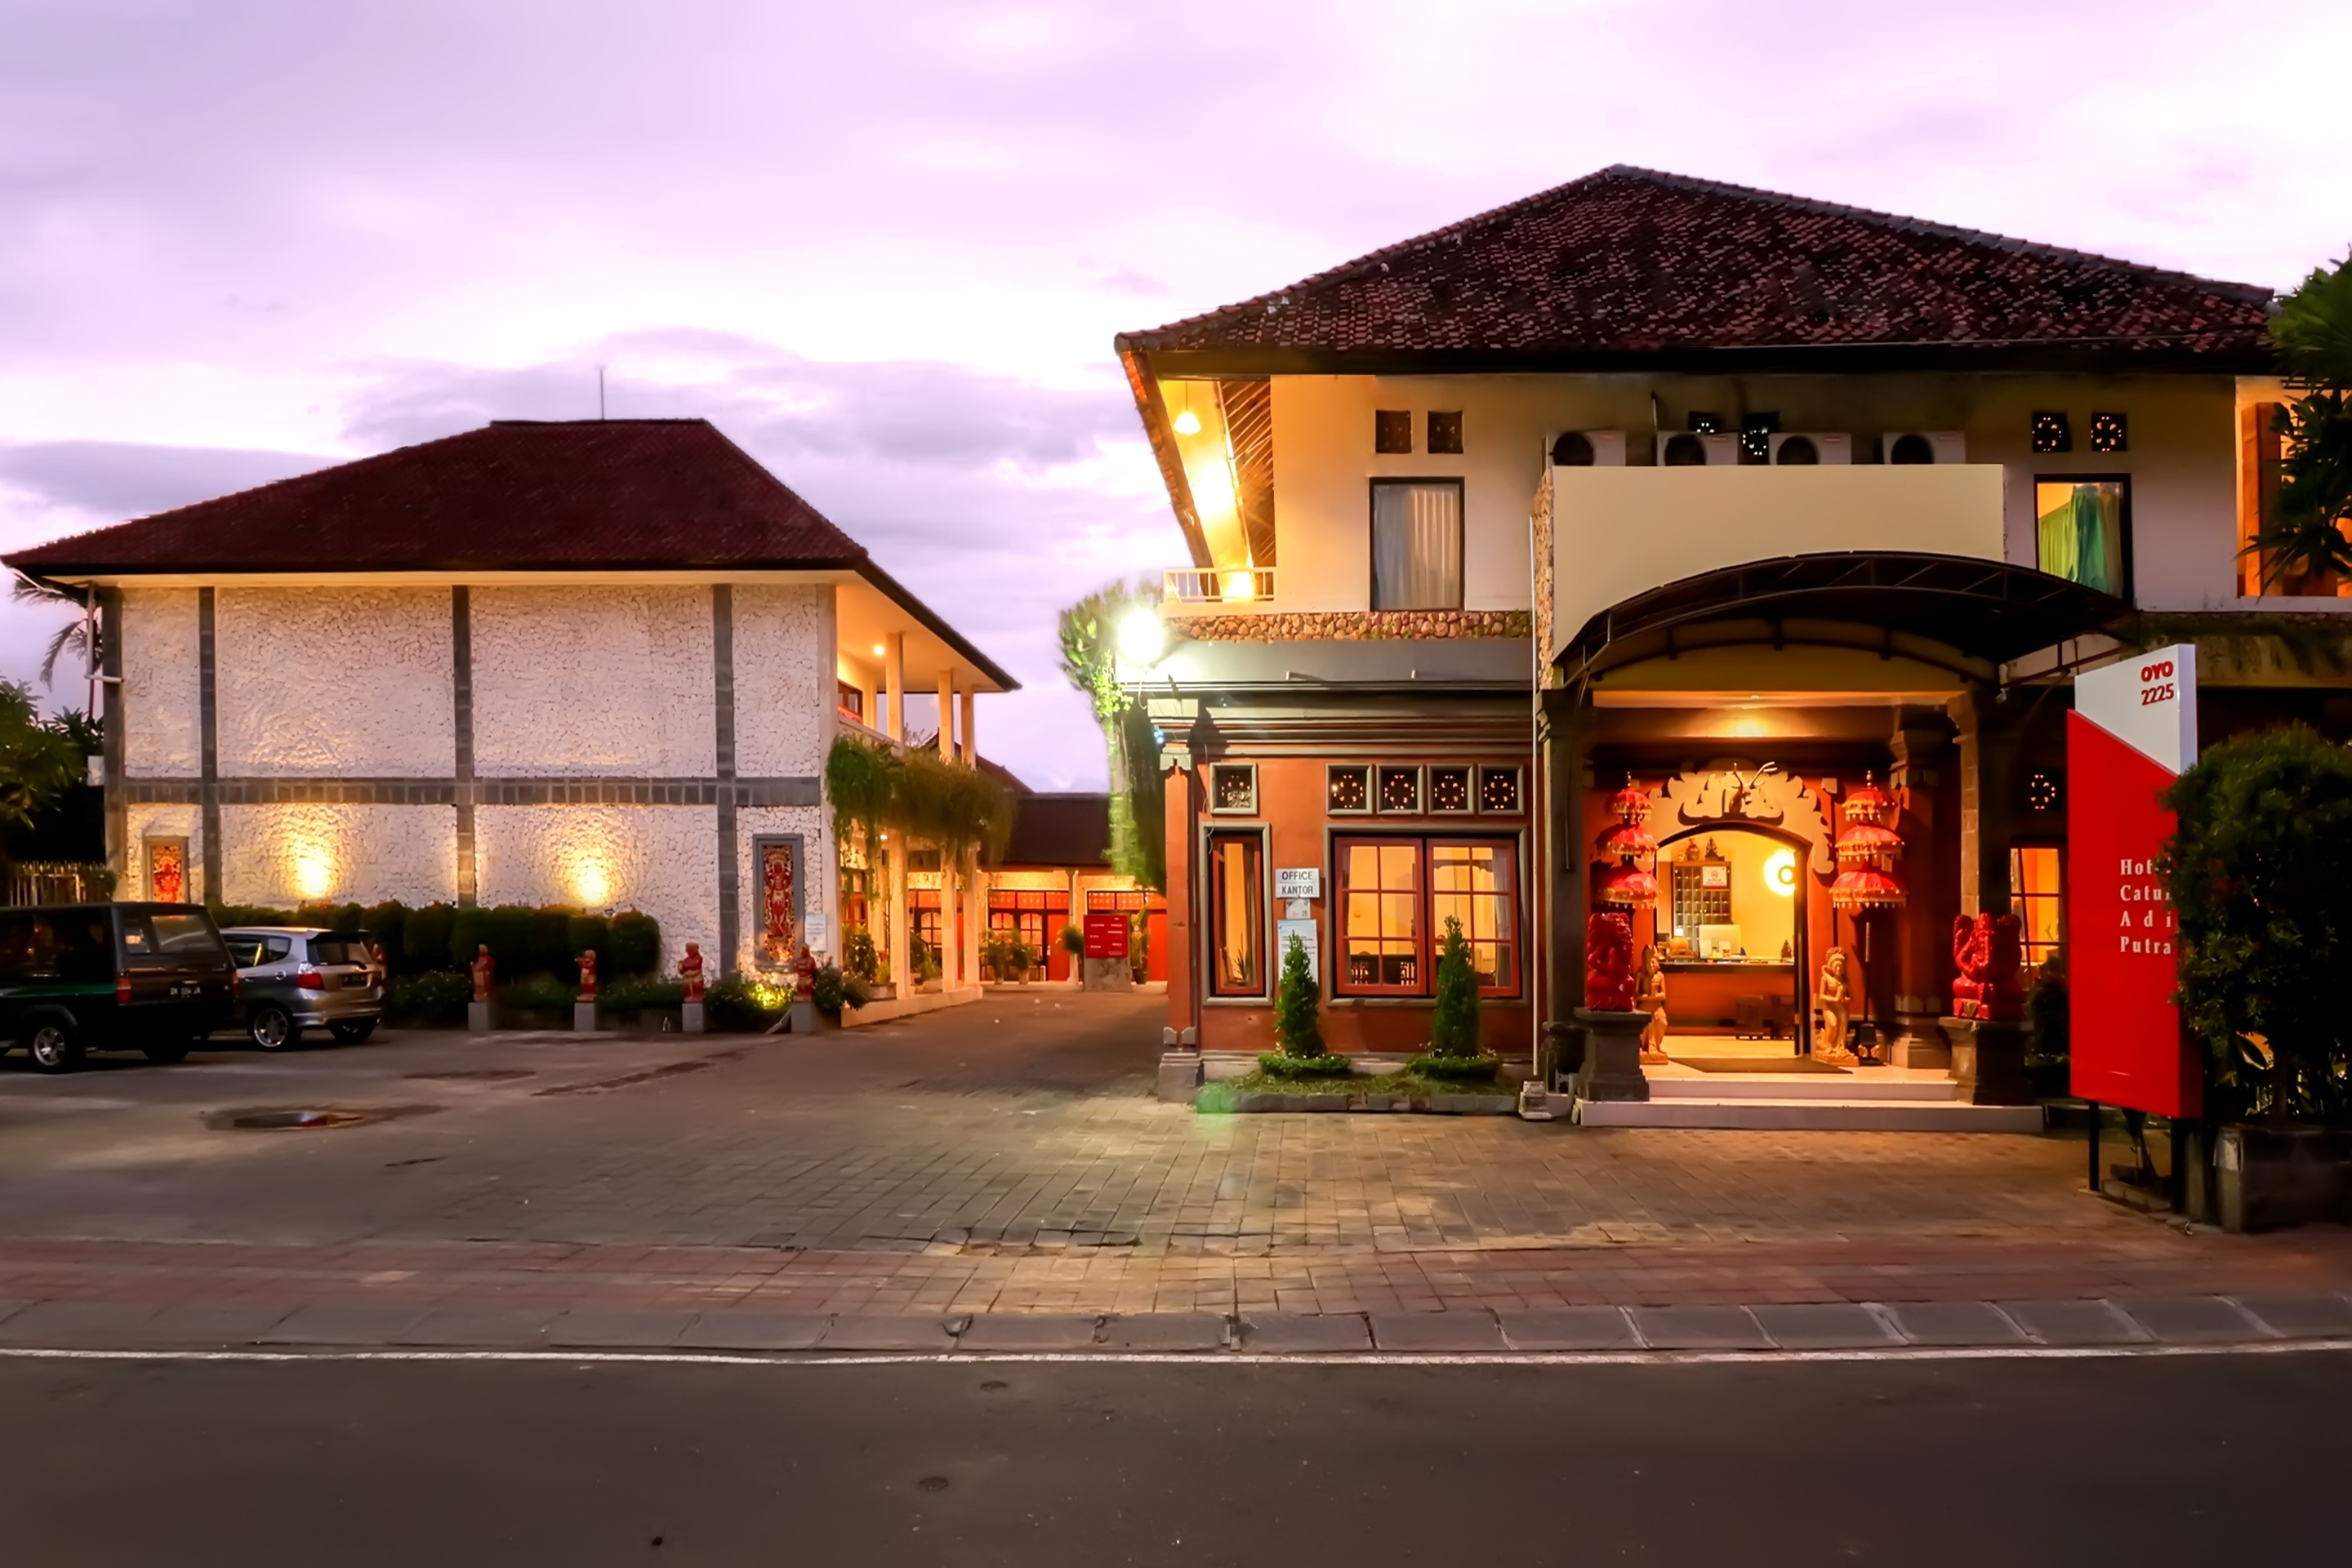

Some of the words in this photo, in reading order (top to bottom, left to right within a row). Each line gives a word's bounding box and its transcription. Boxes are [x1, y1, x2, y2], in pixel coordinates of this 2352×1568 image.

[2141, 661, 2174, 683] OYO
[2141, 683, 2174, 706] 2225
[1281, 871, 1312, 880] OFFICE
[2120, 858, 2172, 875] Hot
[1281, 885, 1313, 894] KANTOR
[2120, 936, 2172, 955] Putra
